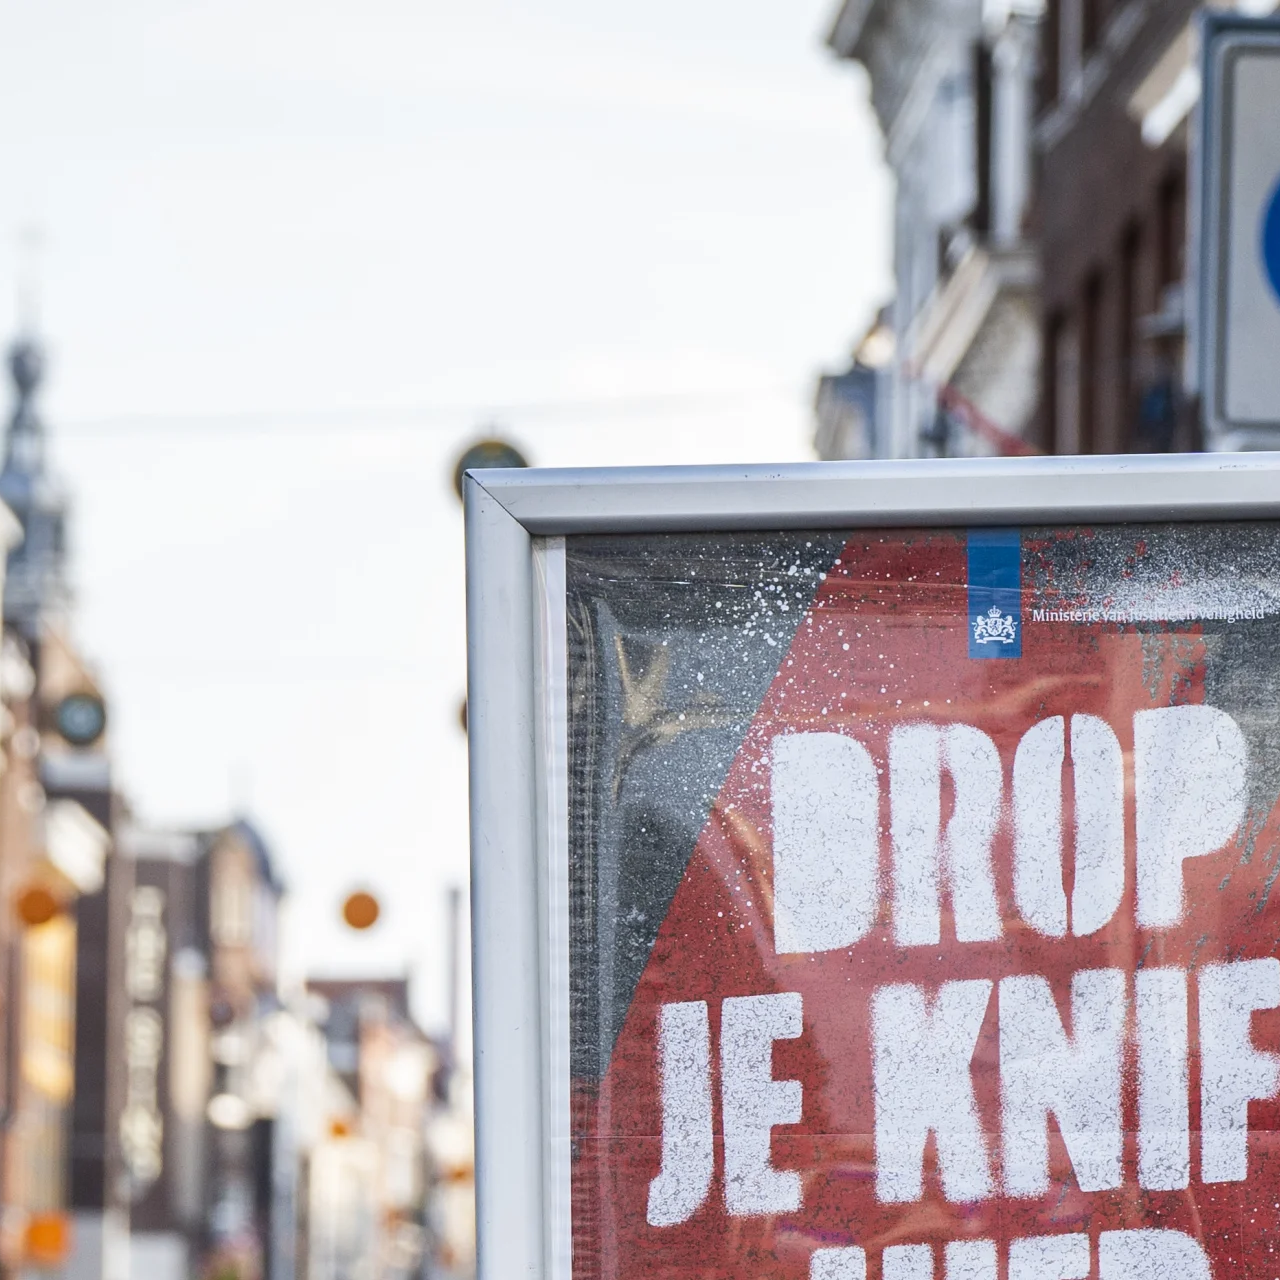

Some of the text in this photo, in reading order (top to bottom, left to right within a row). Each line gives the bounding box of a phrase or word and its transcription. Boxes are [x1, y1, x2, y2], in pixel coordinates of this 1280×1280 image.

[1032, 608, 1100, 622] Ministerie
[1102, 610, 1126, 622] van
[1198, 606, 1264, 623] Veiligheid
[771, 705, 1250, 954] DROP
[647, 992, 804, 1226] JE
